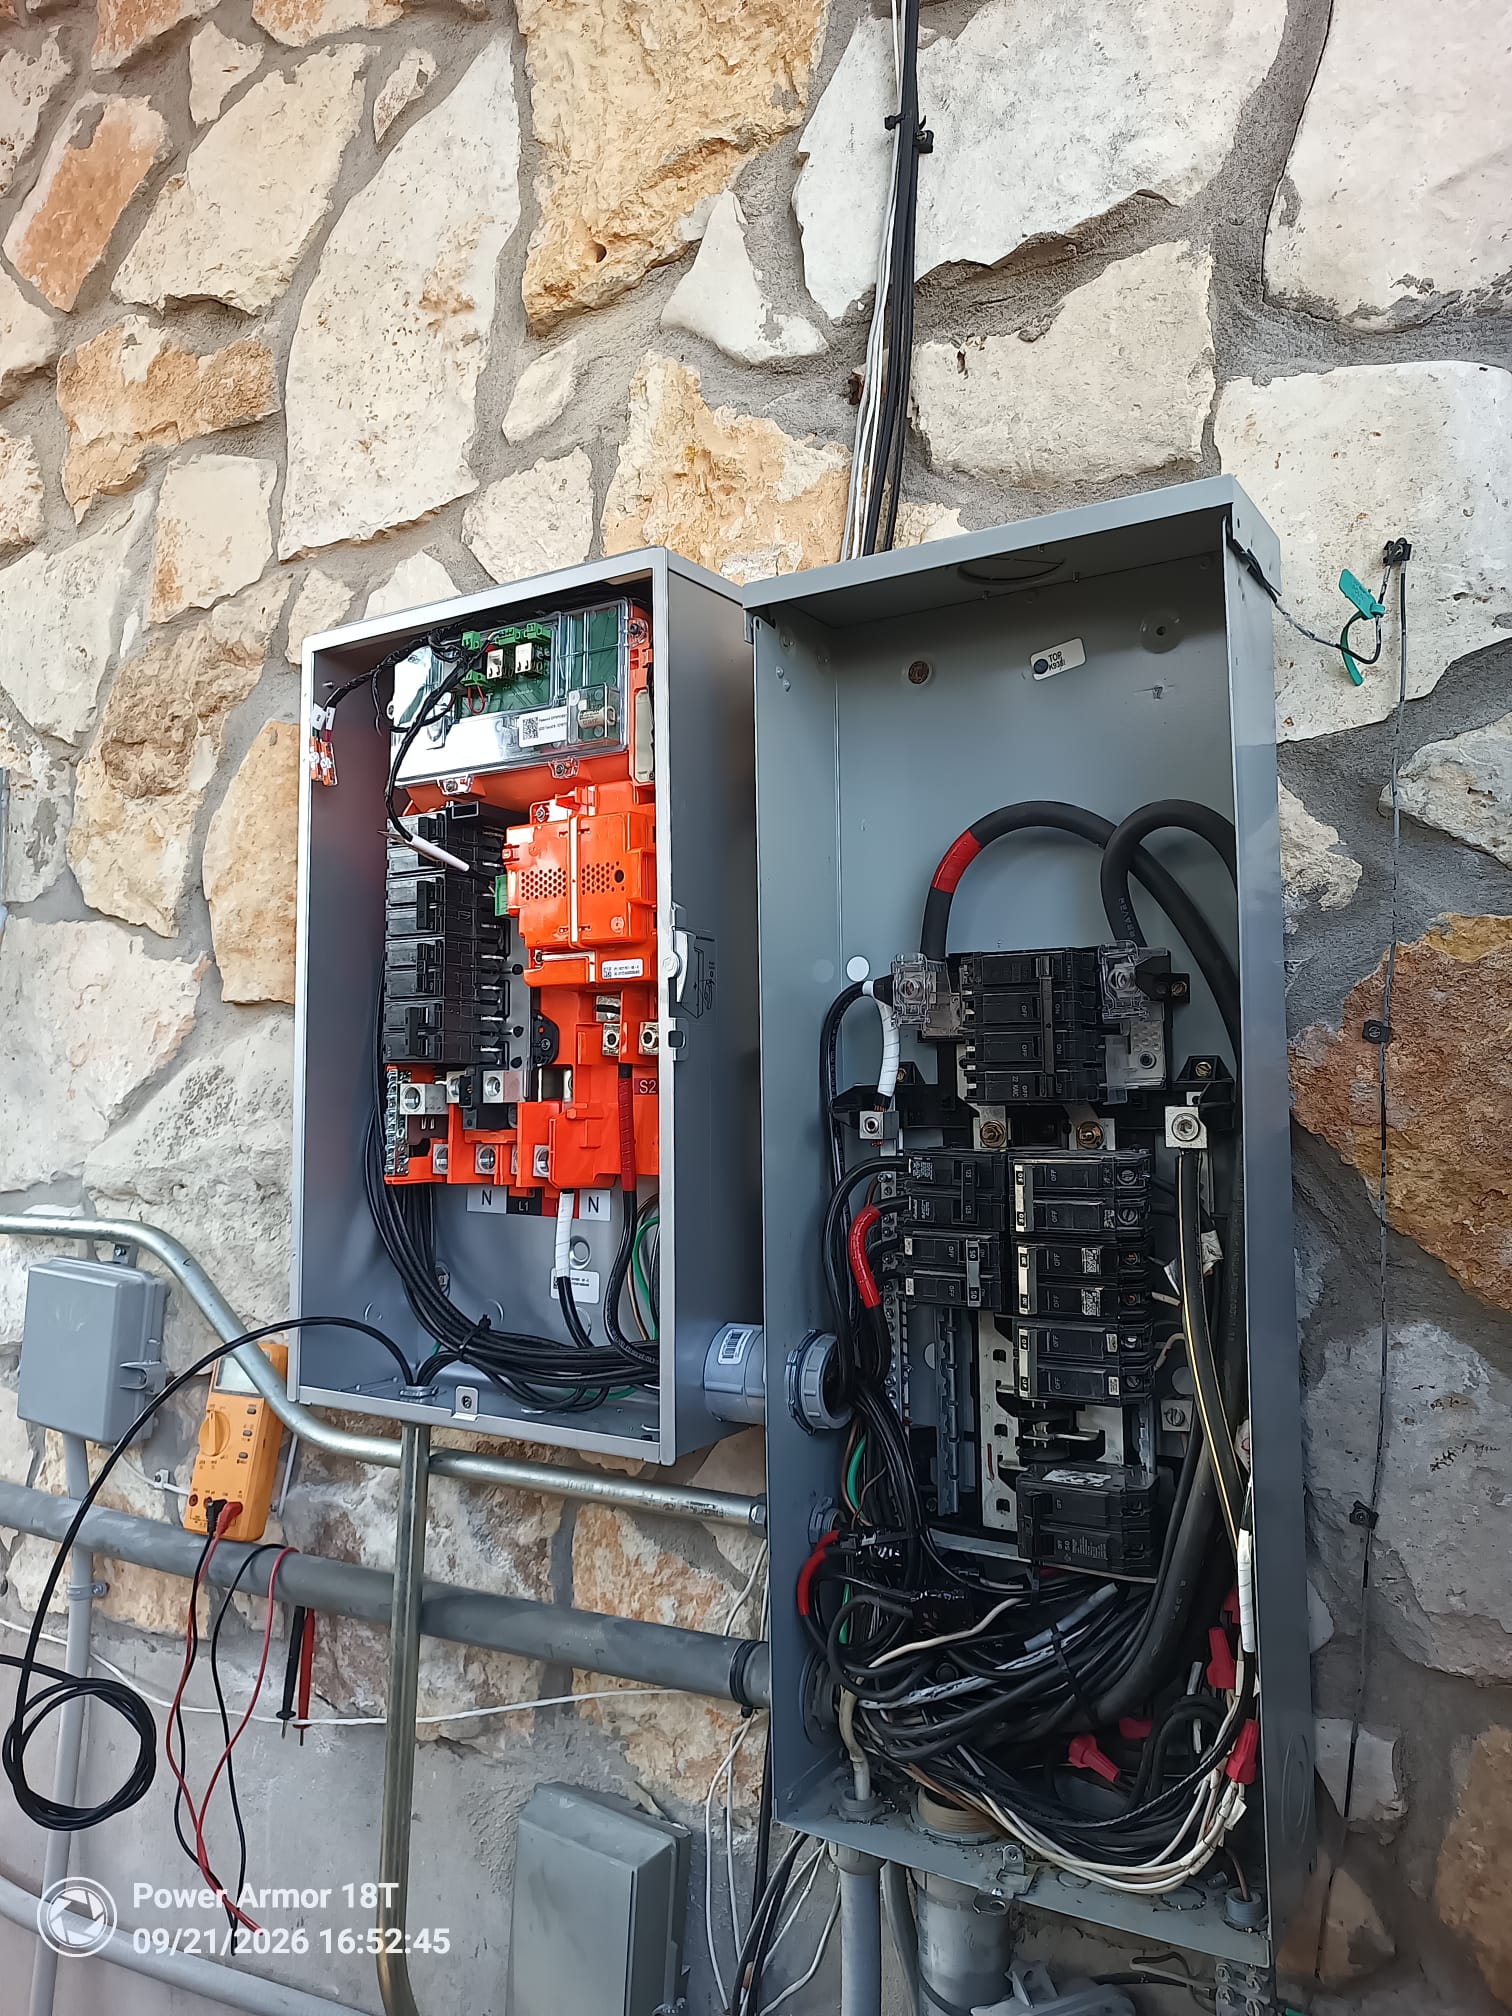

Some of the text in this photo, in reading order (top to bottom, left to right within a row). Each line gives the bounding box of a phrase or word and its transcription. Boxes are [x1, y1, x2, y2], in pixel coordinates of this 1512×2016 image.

[1048, 651, 1062, 663] TOP
[1055, 1003, 1061, 1014] ON
[1056, 1043, 1062, 1055] ON
[640, 1079, 657, 1094] S2
[481, 1189, 492, 1206] N
[518, 1200, 529, 1212] L1
[588, 1195, 599, 1214] N
[969, 1249, 976, 1259] 50
